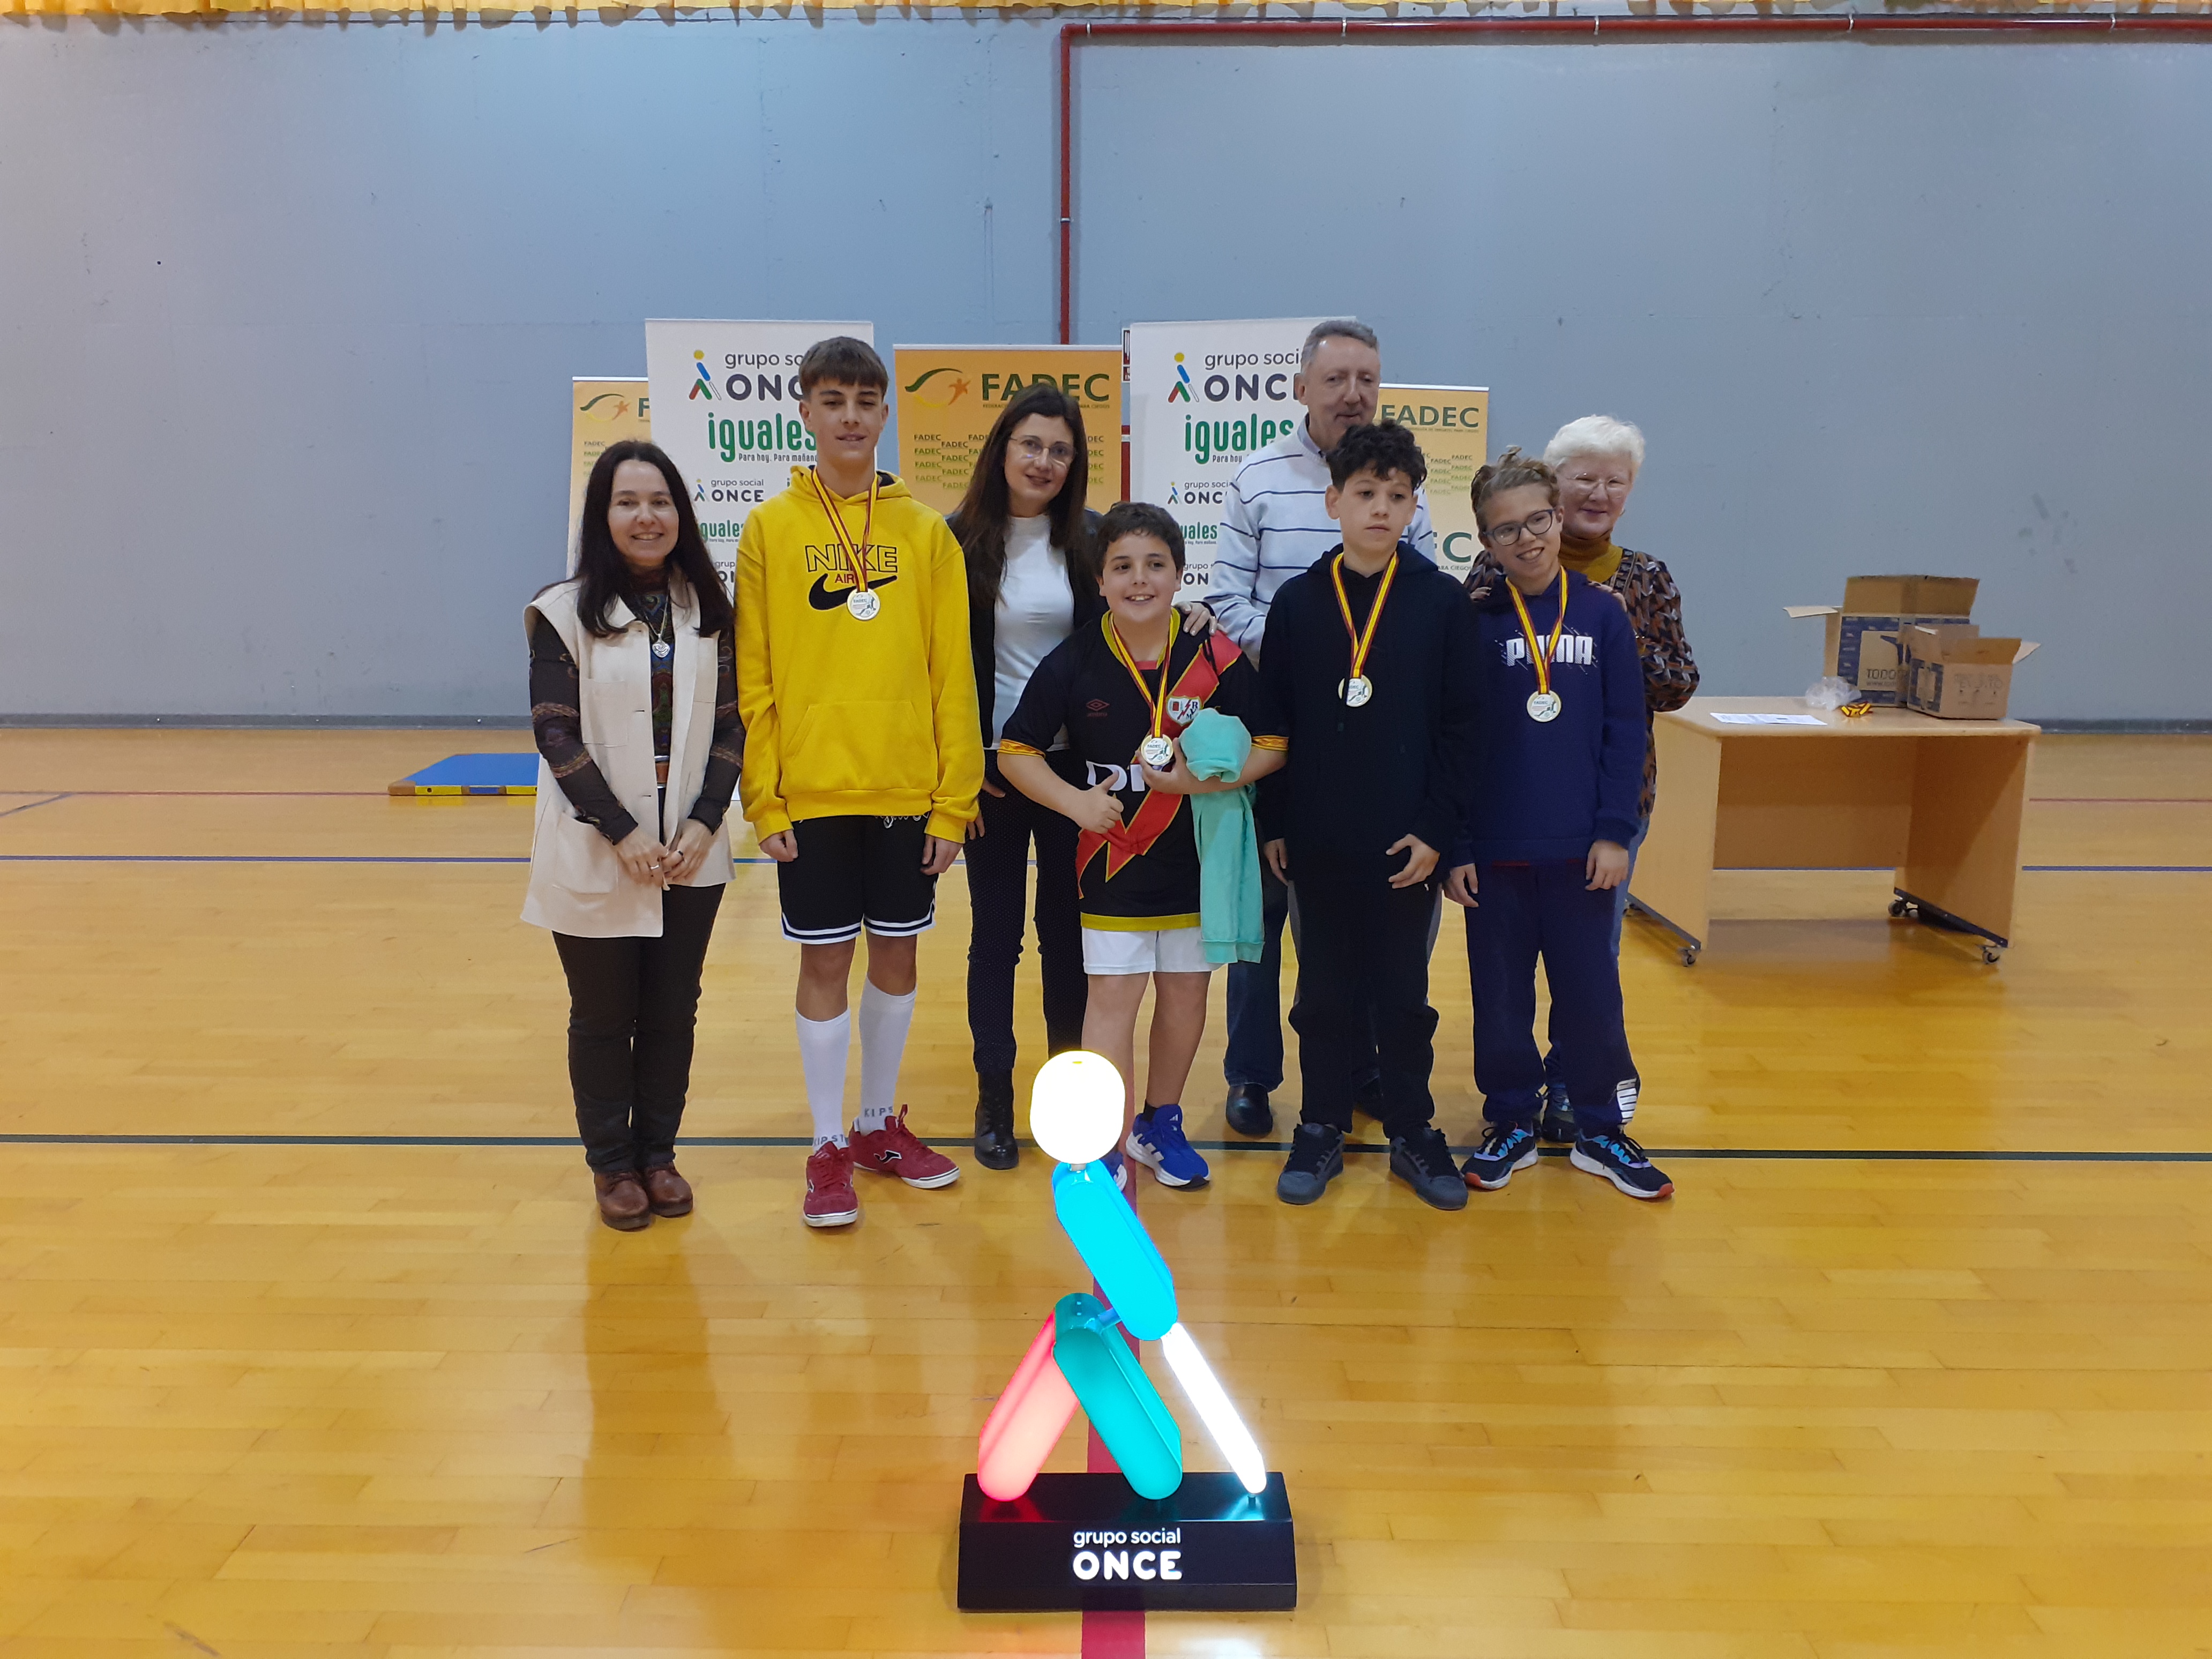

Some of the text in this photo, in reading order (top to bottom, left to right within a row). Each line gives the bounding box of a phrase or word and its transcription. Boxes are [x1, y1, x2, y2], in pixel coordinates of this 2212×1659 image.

[725, 354, 780, 369] grupo
[1205, 348, 1299, 370] grupo soci
[726, 373, 803, 401] ONC
[1205, 373, 1300, 402] ONC
[1381, 405, 1479, 428] FADEC
[757, 453, 772, 463] hoy.
[1213, 455, 1228, 463] Para
[1184, 482, 1209, 490] grupo
[712, 489, 764, 502] ONCE
[1184, 491, 1227, 504] ONC
[700, 520, 744, 543] guale
[1180, 522, 1217, 540] uales
[805, 544, 898, 573] NIKE
[834, 573, 855, 584] AIR
[1183, 572, 1208, 585] ON
[1506, 634, 1593, 667] PUMA
[1867, 669, 1896, 679] TODO
[864, 1107, 893, 1117] KIPS
[814, 1134, 843, 1146] IPST
[1073, 1527, 1181, 1548] grupo social
[1073, 1551, 1182, 1581] ONCE
